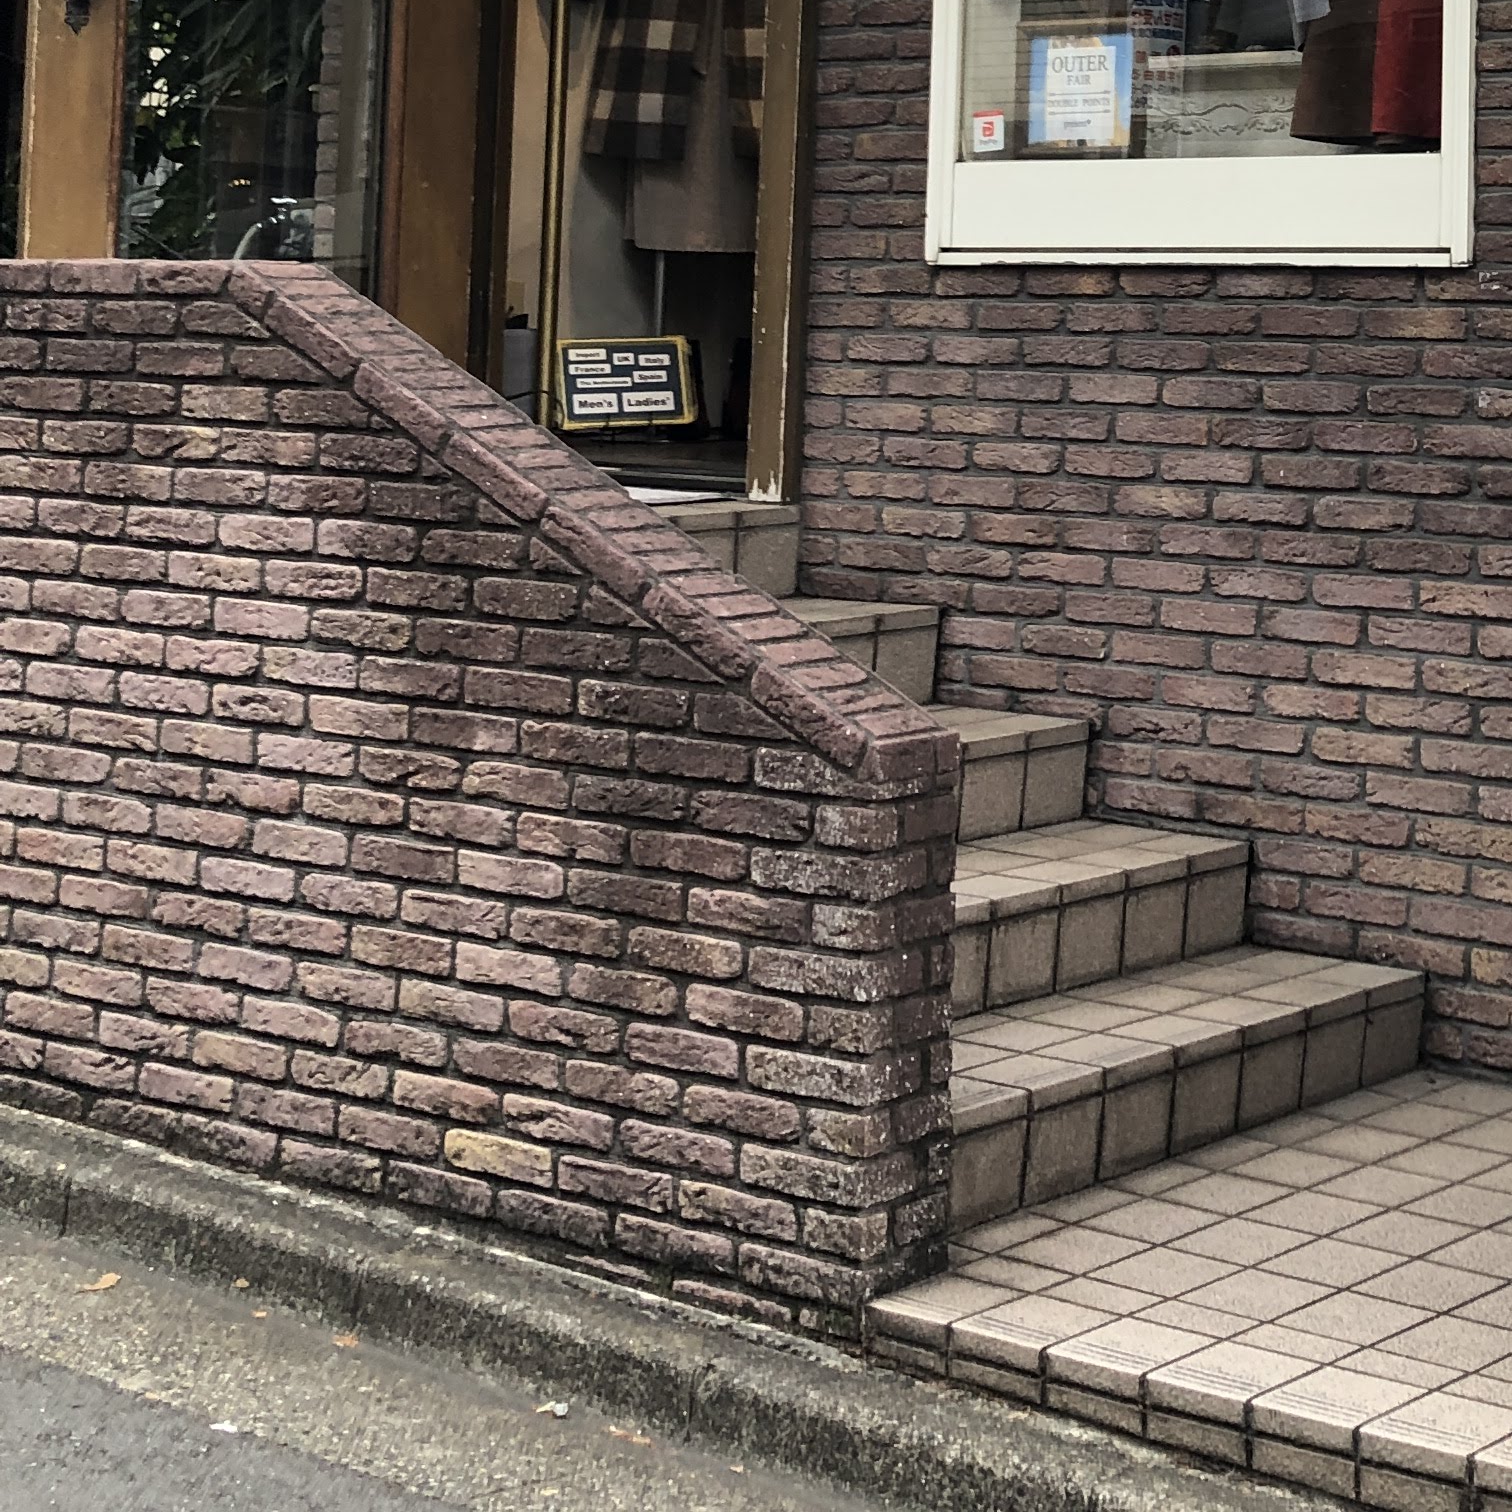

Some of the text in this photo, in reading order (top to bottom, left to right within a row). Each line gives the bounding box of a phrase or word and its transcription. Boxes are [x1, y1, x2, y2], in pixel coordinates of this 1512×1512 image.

[1051, 54, 1110, 74] OUTER
[1066, 74, 1092, 86] FAIR
[578, 399, 614, 409] Men's
